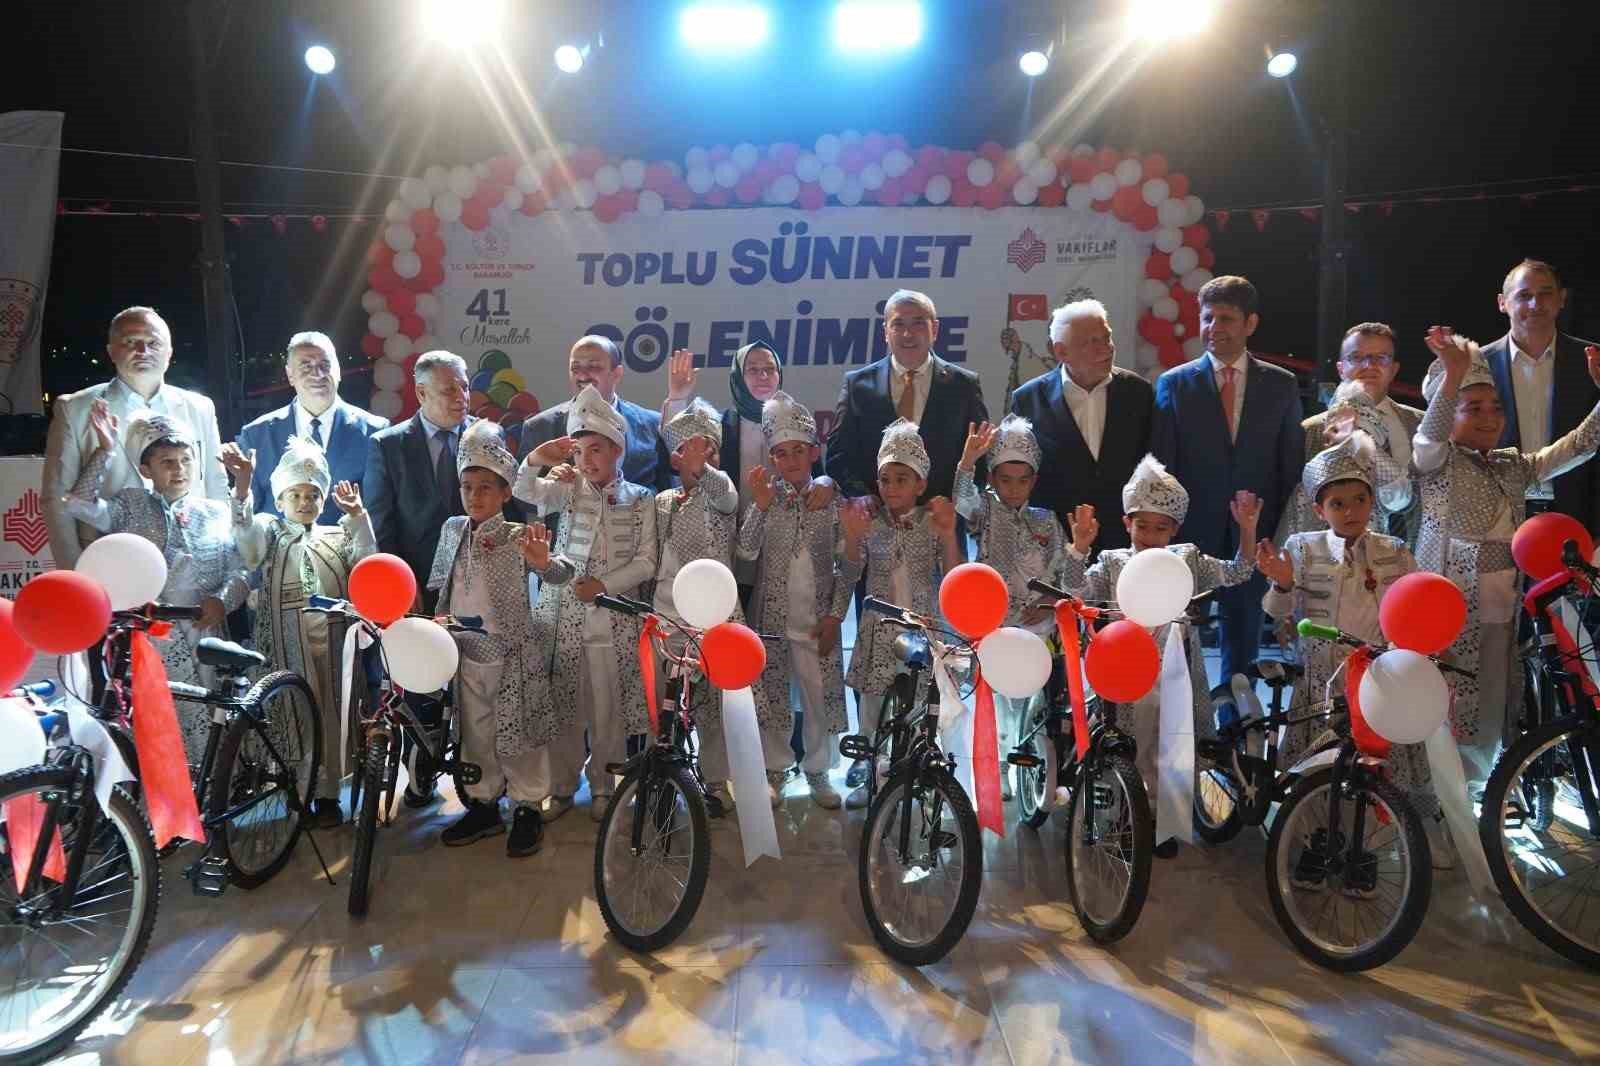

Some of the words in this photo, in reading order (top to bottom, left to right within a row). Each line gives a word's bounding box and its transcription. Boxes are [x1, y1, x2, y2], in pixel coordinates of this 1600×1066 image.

[576, 251, 717, 287] TOPLU
[729, 221, 972, 285] SÜNNET
[1056, 240, 1117, 255] VAKIFLAR
[465, 288, 510, 322] 41
[584, 300, 969, 373] ÖLENİMİE
[25, 560, 41, 569] T.C.
